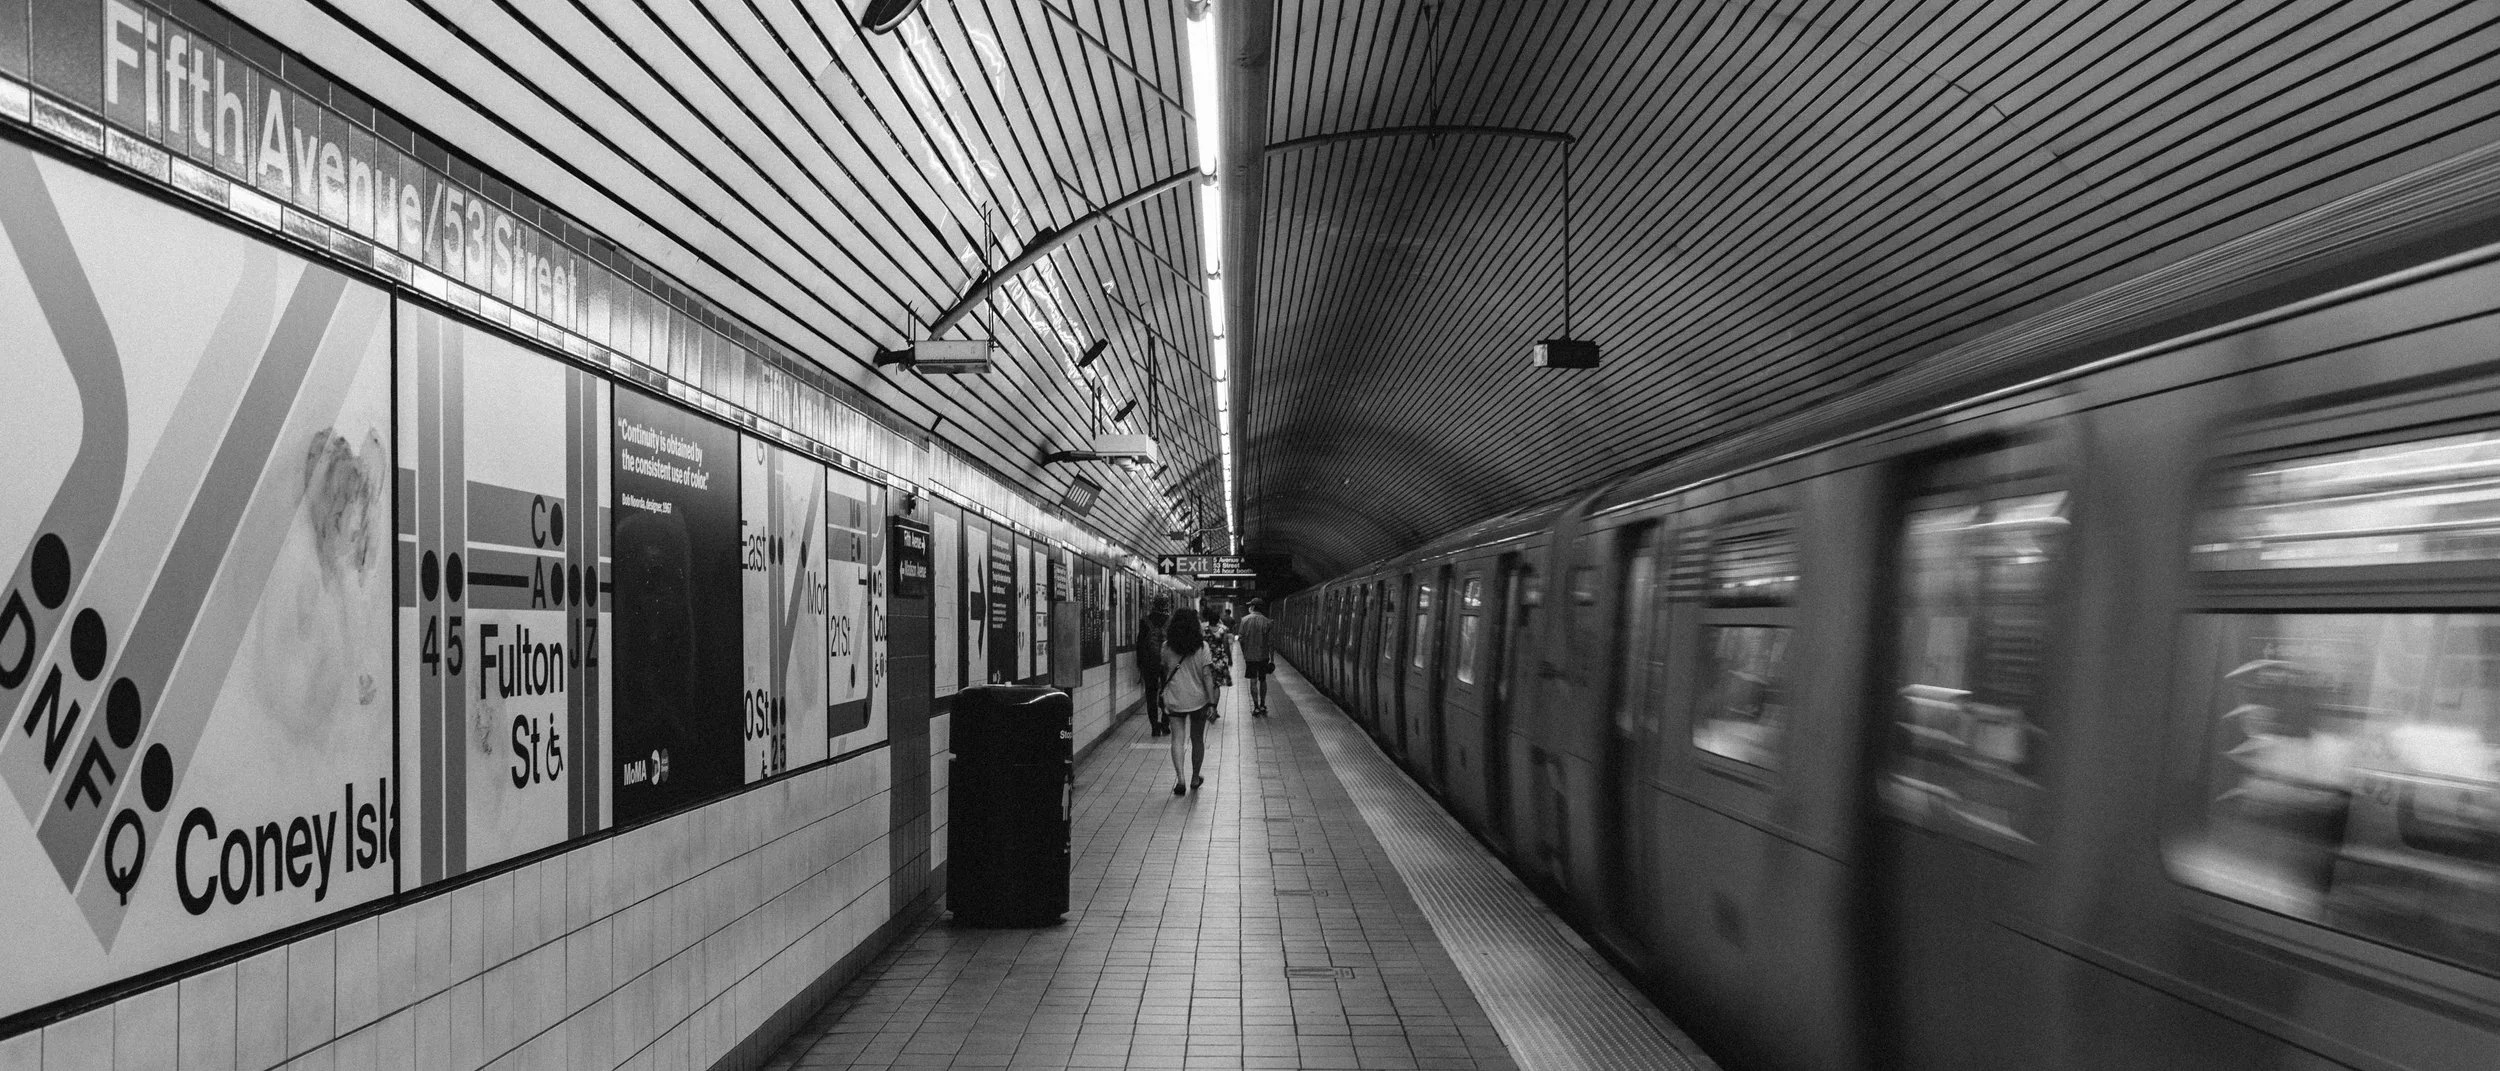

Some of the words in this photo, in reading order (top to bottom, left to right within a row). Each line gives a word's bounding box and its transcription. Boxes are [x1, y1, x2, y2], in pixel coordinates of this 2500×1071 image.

[107, 0, 245, 165] Fifth
[258, 88, 486, 276] Avenue/53
[493, 215, 577, 324] Street
[622, 448, 635, 472] the
[635, 456, 671, 481] consistent
[671, 466, 682, 484] use
[683, 466, 690, 486] of
[660, 430, 666, 452] is
[666, 433, 695, 460] obtained
[695, 442, 703, 467] by
[531, 494, 546, 549] C
[531, 556, 547, 609] A
[877, 570, 882, 597] G
[1176, 557, 1208, 572] Exit
[0, 588, 36, 690] D
[422, 615, 440, 676] 4
[447, 615, 463, 676] 5
[480, 623, 564, 700] Fulton
[570, 618, 580, 669] J
[585, 618, 597, 668] Z
[23, 663, 82, 775] N
[756, 689, 769, 738] St
[64, 735, 117, 812] F
[511, 714, 540, 789] St
[624, 760, 647, 786] MoMA
[772, 735, 778, 771] 2
[780, 734, 786, 769] 5
[104, 808, 146, 907] Q
[176, 807, 337, 916] Coney
[345, 777, 393, 873] Isl
